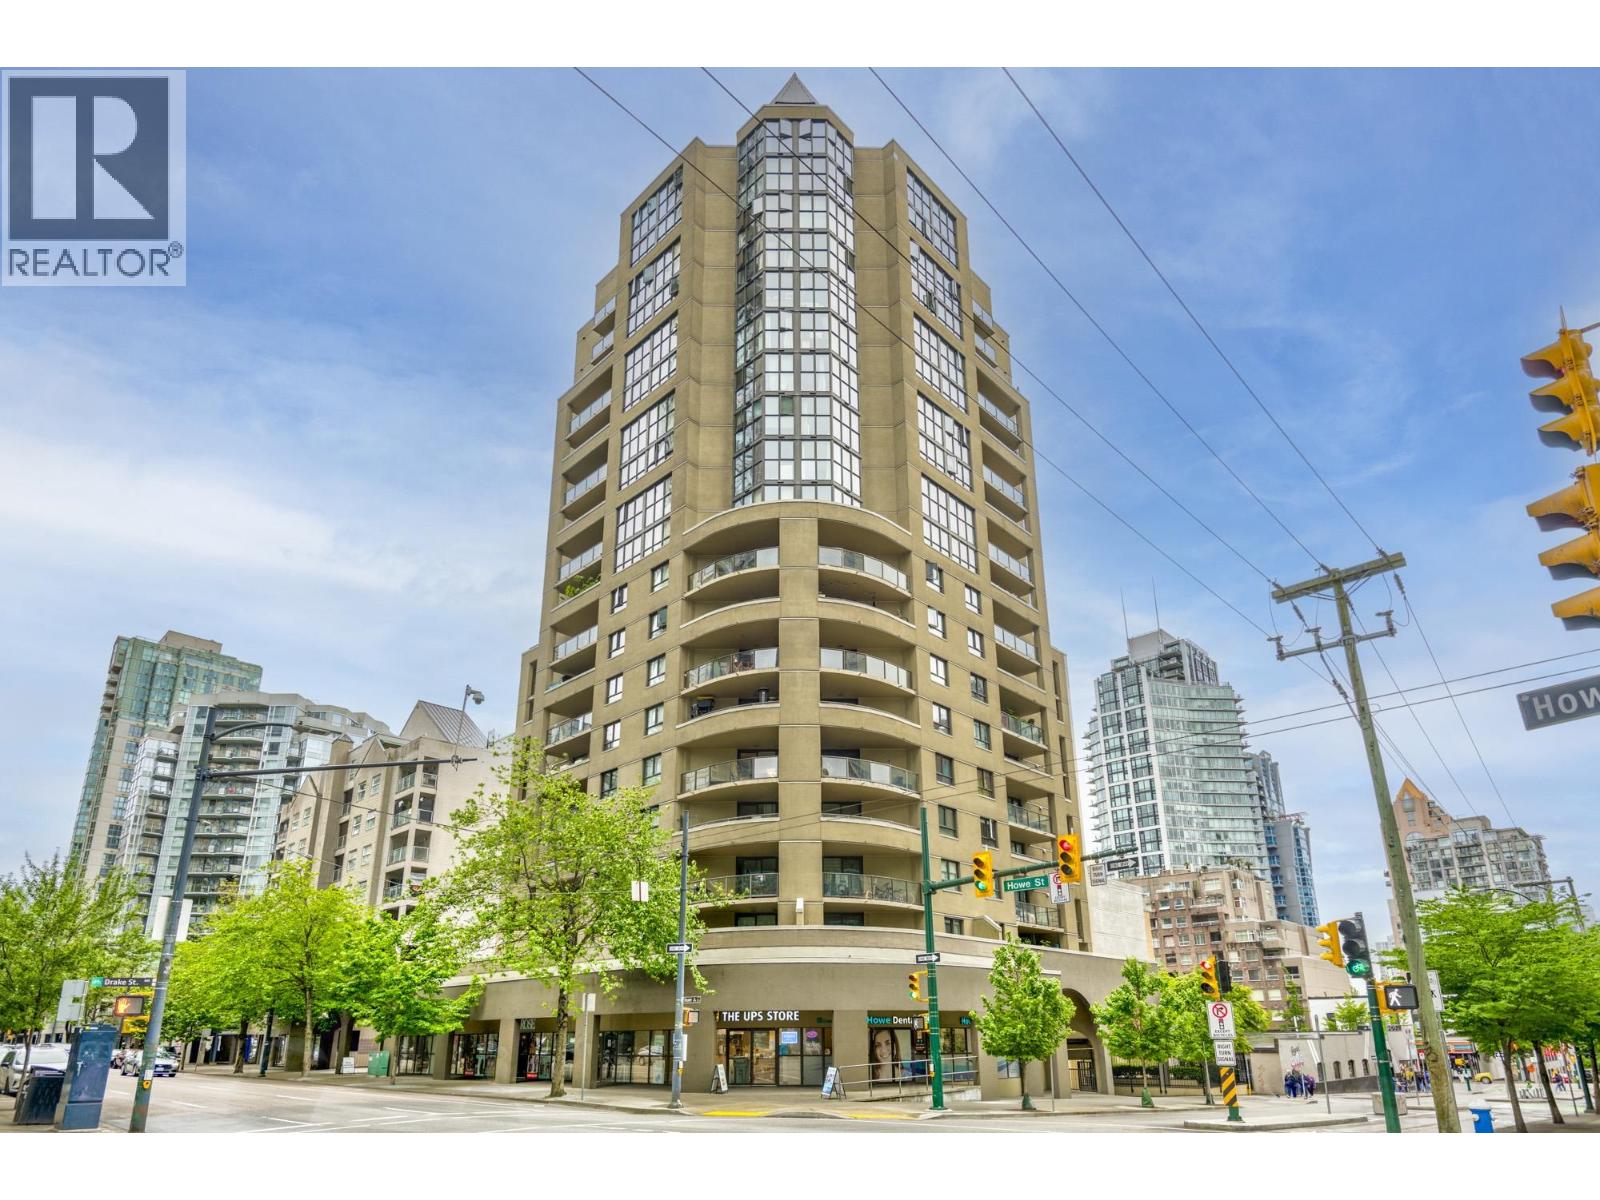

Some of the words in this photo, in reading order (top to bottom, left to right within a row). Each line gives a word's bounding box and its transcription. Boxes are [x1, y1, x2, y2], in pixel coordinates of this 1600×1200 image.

[1006, 880, 1032, 891] Howe
[1034, 877, 1046, 888] St
[722, 1010, 740, 1022] THE
[743, 1010, 763, 1021] UPS
[766, 1010, 800, 1021] STORE
[866, 1015, 892, 1025] Howe
